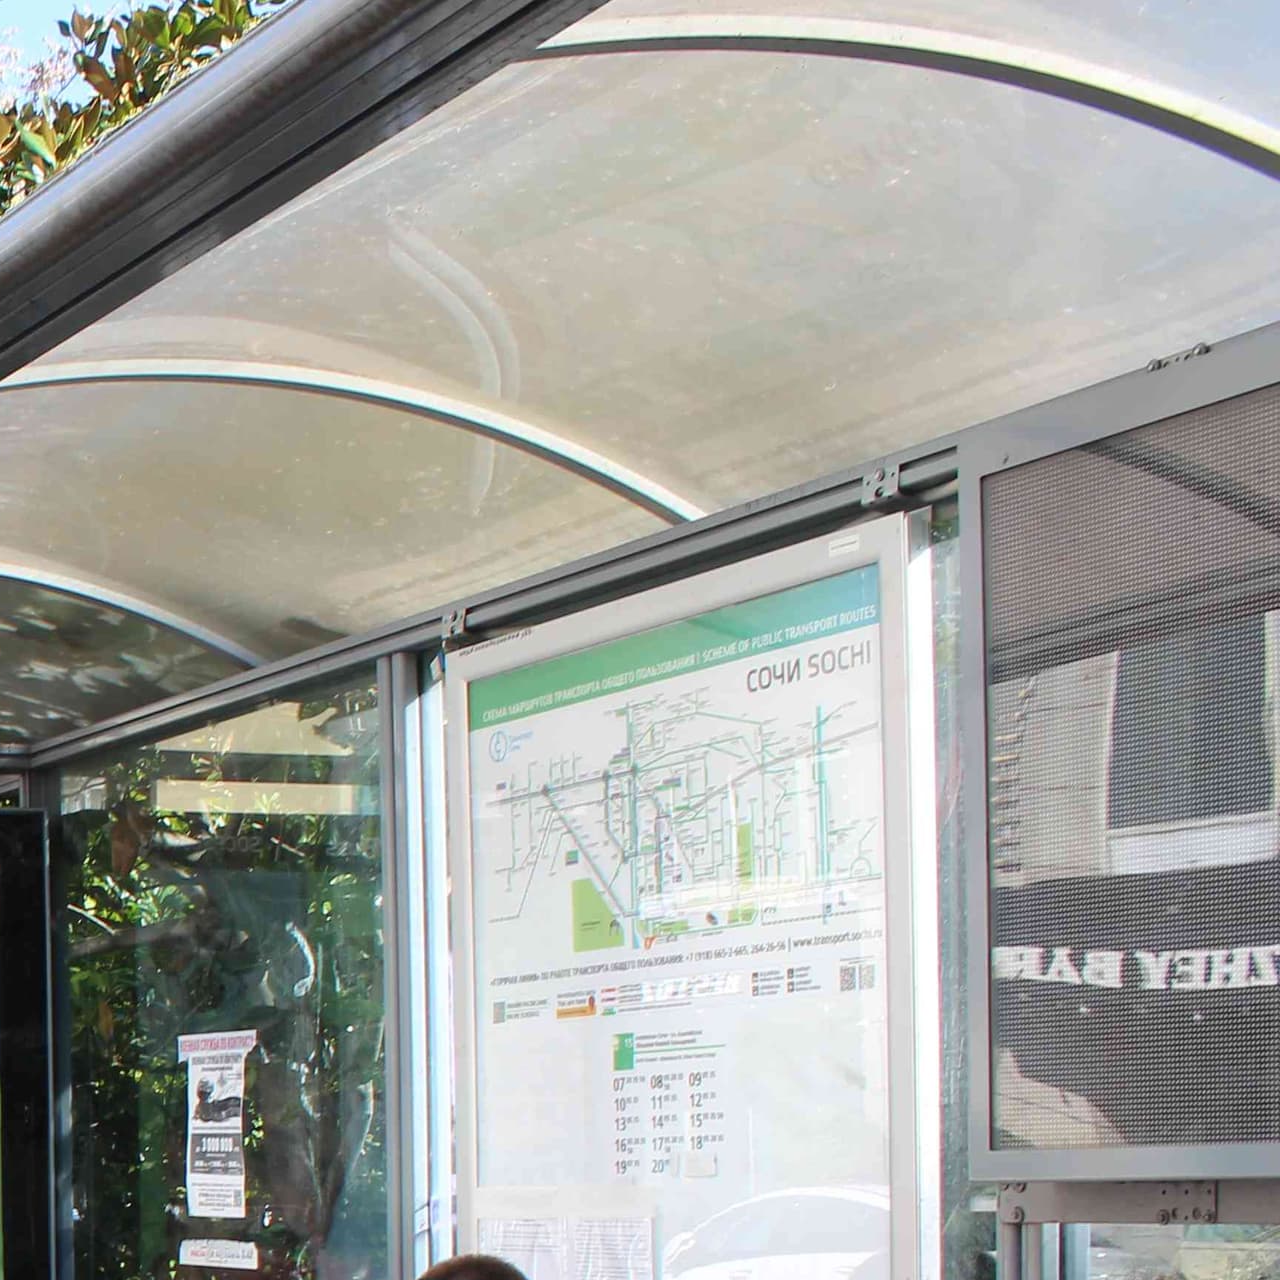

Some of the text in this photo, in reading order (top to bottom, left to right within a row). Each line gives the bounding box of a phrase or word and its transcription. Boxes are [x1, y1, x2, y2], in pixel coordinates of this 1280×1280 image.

[738, 636, 751, 651] OF
[752, 630, 784, 649] PUBLIC
[784, 615, 838, 641] TRANSPORT
[840, 604, 876, 626] ROUTES
[746, 640, 872, 693] СОЧИ SOCHI
[613, 1077, 625, 1091] 07
[650, 1075, 663, 1089] 08
[688, 1072, 702, 1086] 09
[614, 1097, 626, 1111] 10
[651, 1095, 663, 1110] 11
[690, 1092, 702, 1108] 12
[615, 1117, 627, 1131] 13
[652, 1115, 664, 1129] 14
[690, 1113, 703, 1128] 15
[615, 1138, 627, 1152] 16
[652, 1136, 665, 1151] 17
[690, 1135, 703, 1150] 18
[615, 1160, 627, 1175] 19
[651, 1159, 664, 1173] 20
